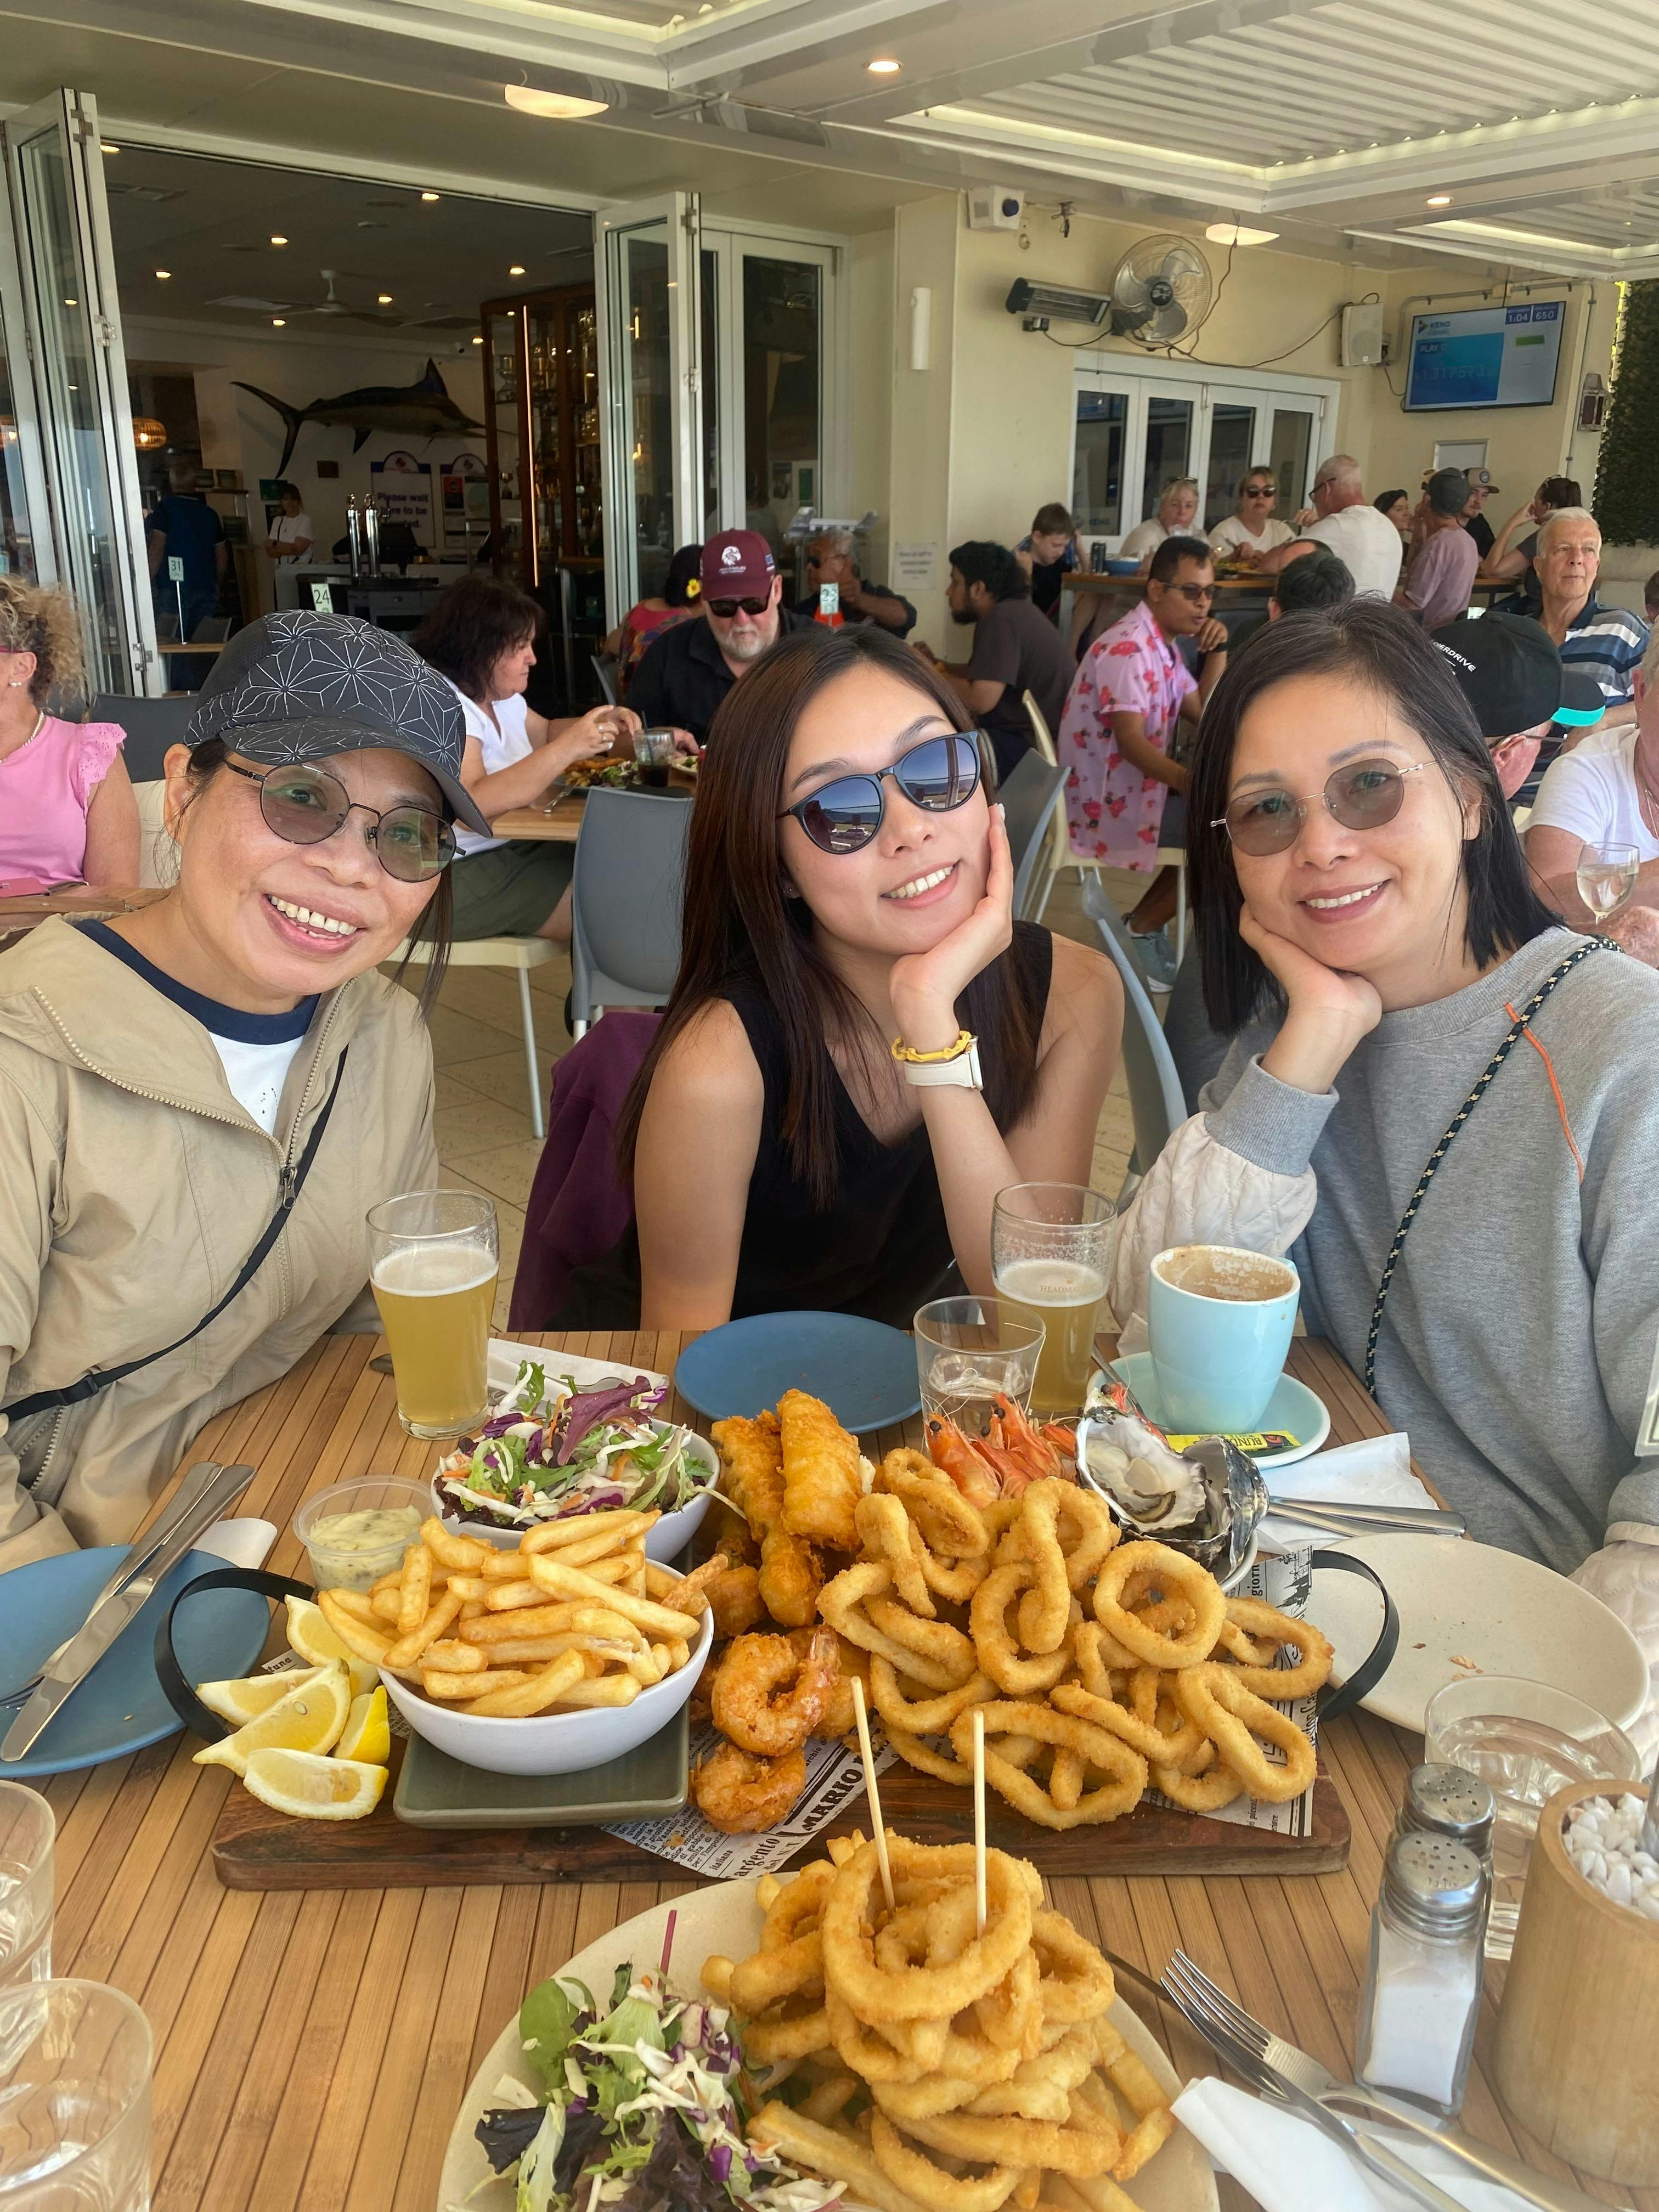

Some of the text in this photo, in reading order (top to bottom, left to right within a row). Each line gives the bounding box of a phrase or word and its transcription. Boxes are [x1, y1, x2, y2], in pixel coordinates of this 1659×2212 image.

[415, 506, 427, 515] be
[171, 560, 181, 571] 31
[313, 589, 330, 604] 24
[822, 589, 837, 602] 23
[802, 1768, 863, 1831] MARIO
[656, 1818, 681, 1842] Vassallo
[686, 1835, 712, 1863] multa di
[733, 1838, 781, 1877] argento
[691, 1857, 703, 1868] per
[708, 1847, 733, 1871] italiana
